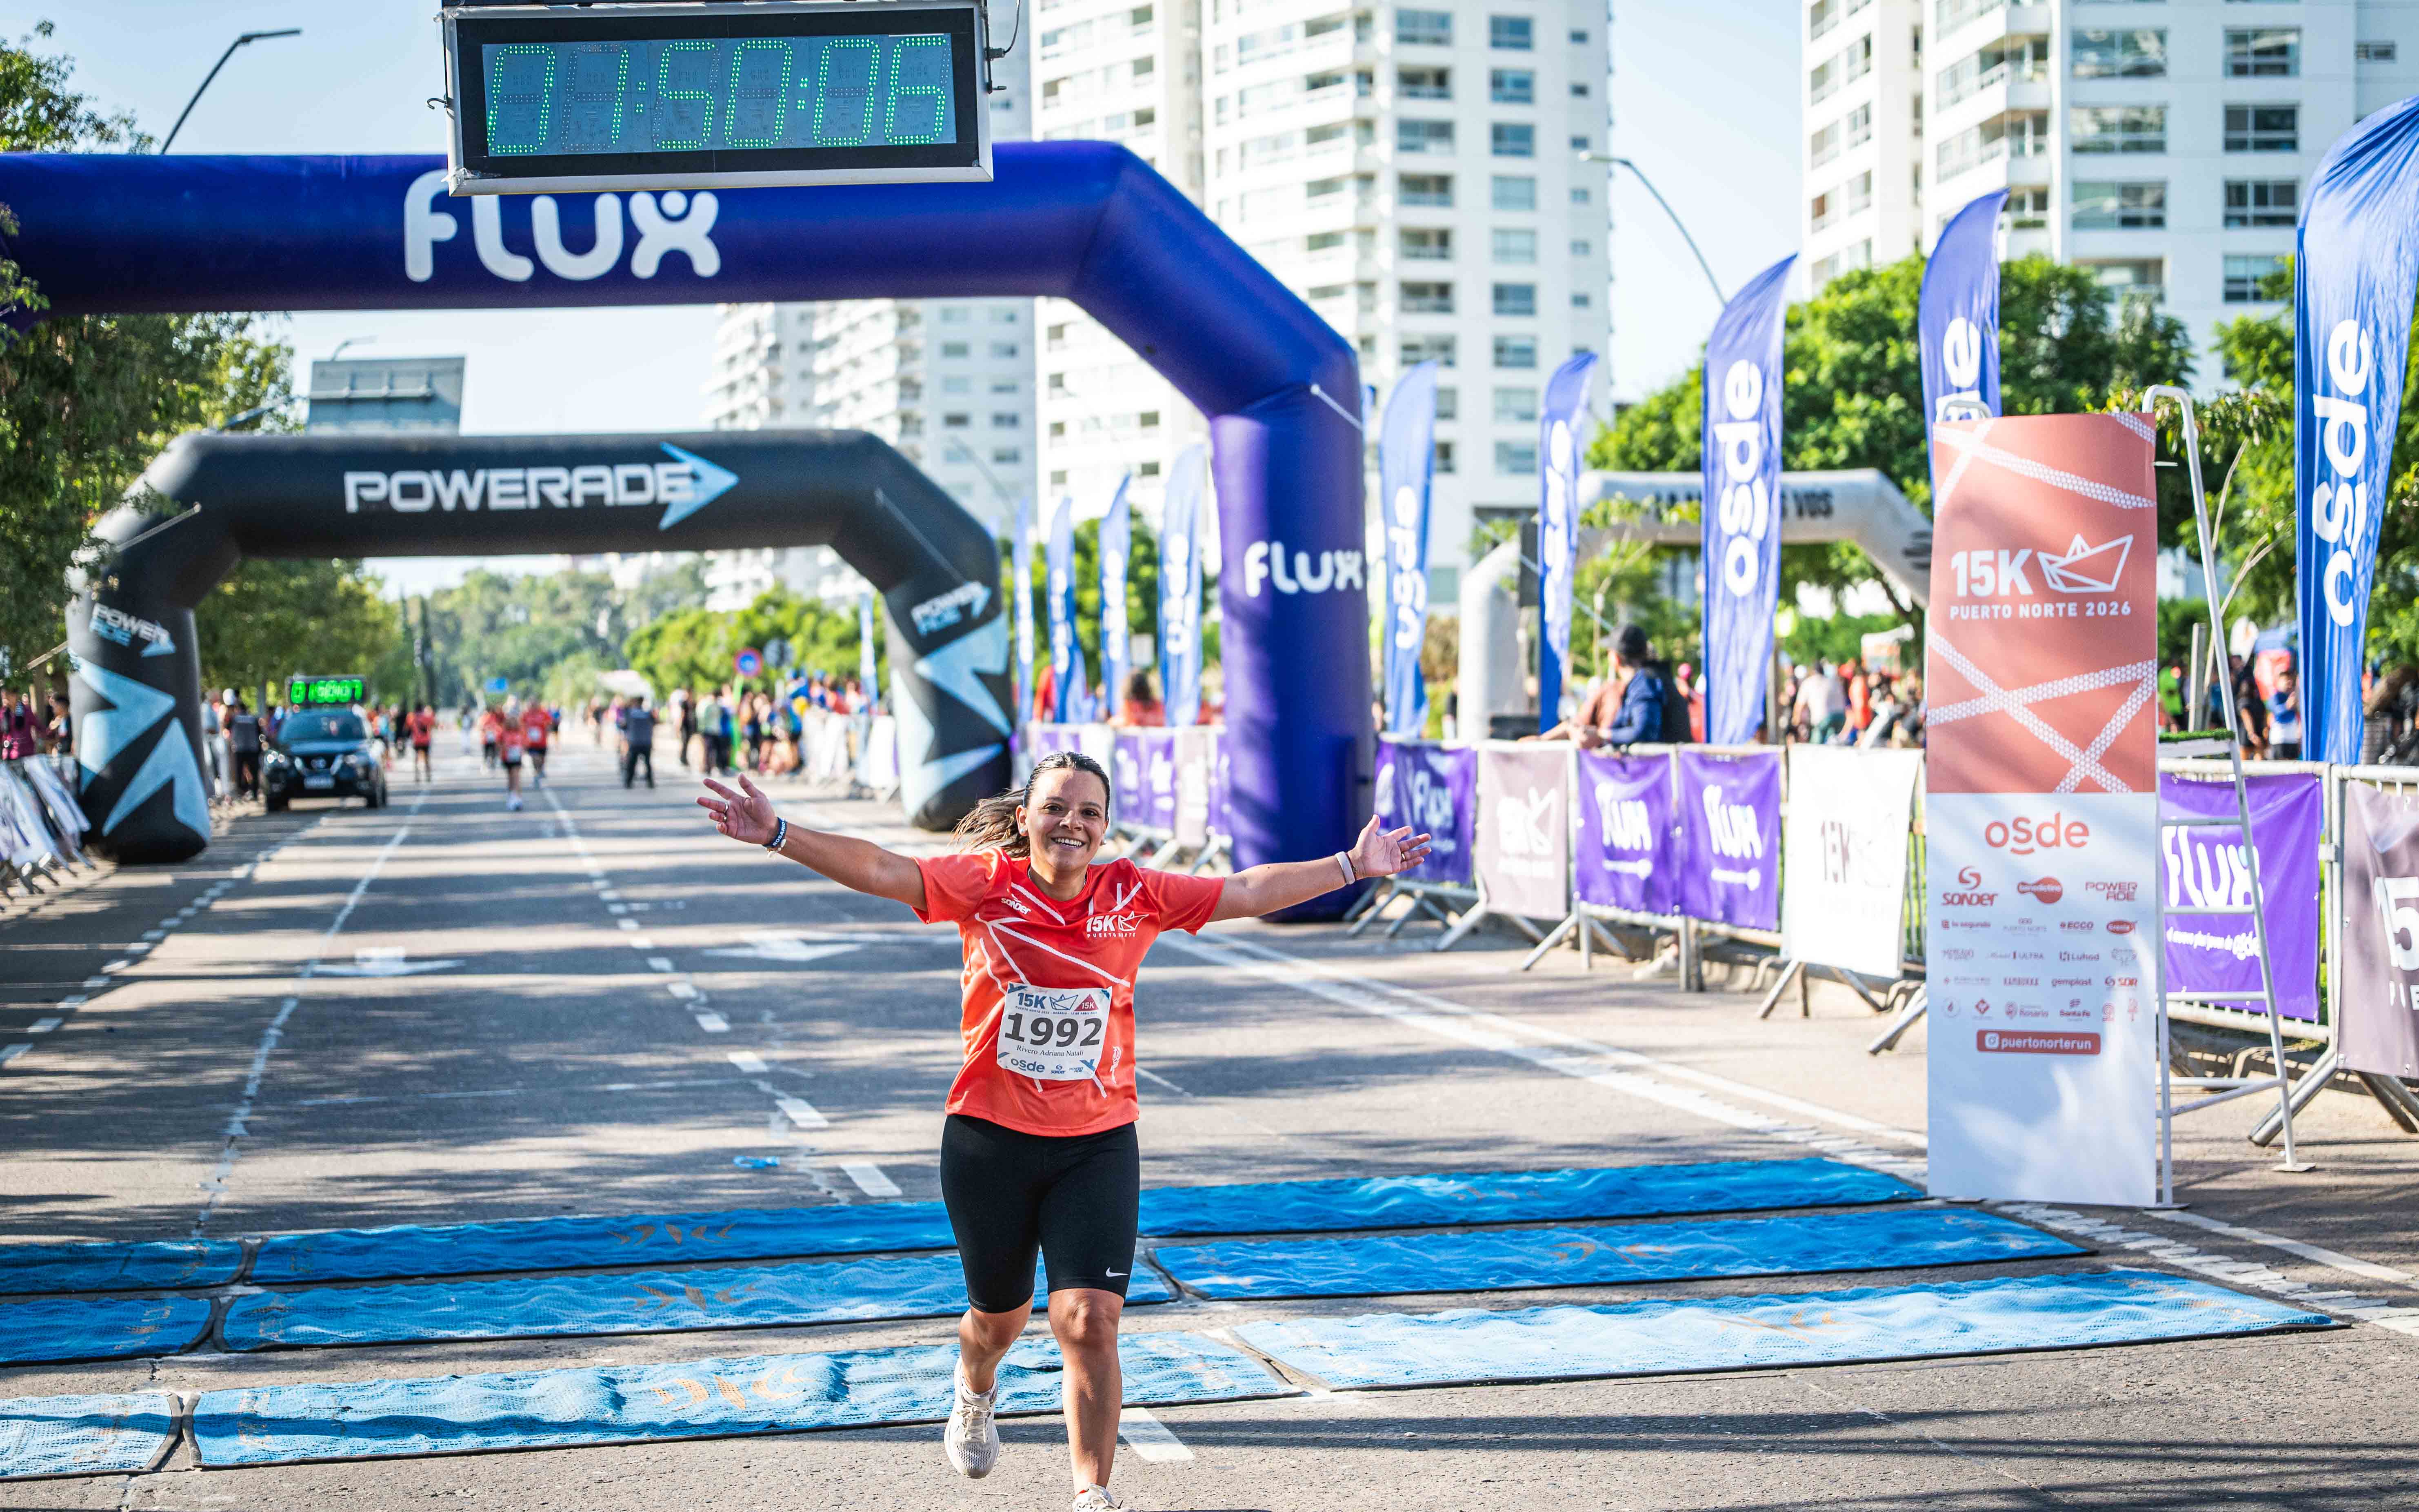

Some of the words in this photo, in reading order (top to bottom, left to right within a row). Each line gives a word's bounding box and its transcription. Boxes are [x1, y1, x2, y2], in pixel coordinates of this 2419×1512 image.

[487, 35, 952, 154] 01:50:06
[1714, 359, 1771, 597] osde
[2312, 319, 2370, 627] osde
[344, 463, 695, 513] POWERADE
[1950, 548, 2033, 597] 15K
[1950, 603, 2012, 620] PUERTO
[2019, 602, 2077, 619] NORTE
[2085, 601, 2131, 617] 2026
[772, 821, 786, 846] ROSARIO
[1985, 812, 2089, 853] osde
[2085, 881, 2138, 893] POWER
[1086, 915, 1118, 933] 15K
[2067, 921, 2094, 929] ECCO
[2117, 977, 2138, 987] SDR
[1017, 992, 1047, 1009] 15K
[1081, 1001, 1095, 1010] 15K
[2019, 1009, 2049, 1017] Rosario
[2059, 1009, 2081, 1018] Santa
[1004, 1012, 1102, 1047] 1992
[1016, 1044, 1038, 1055] Rivero
[2001, 1037, 2092, 1050] puertonorterun
[1011, 1058, 1045, 1072] osde
